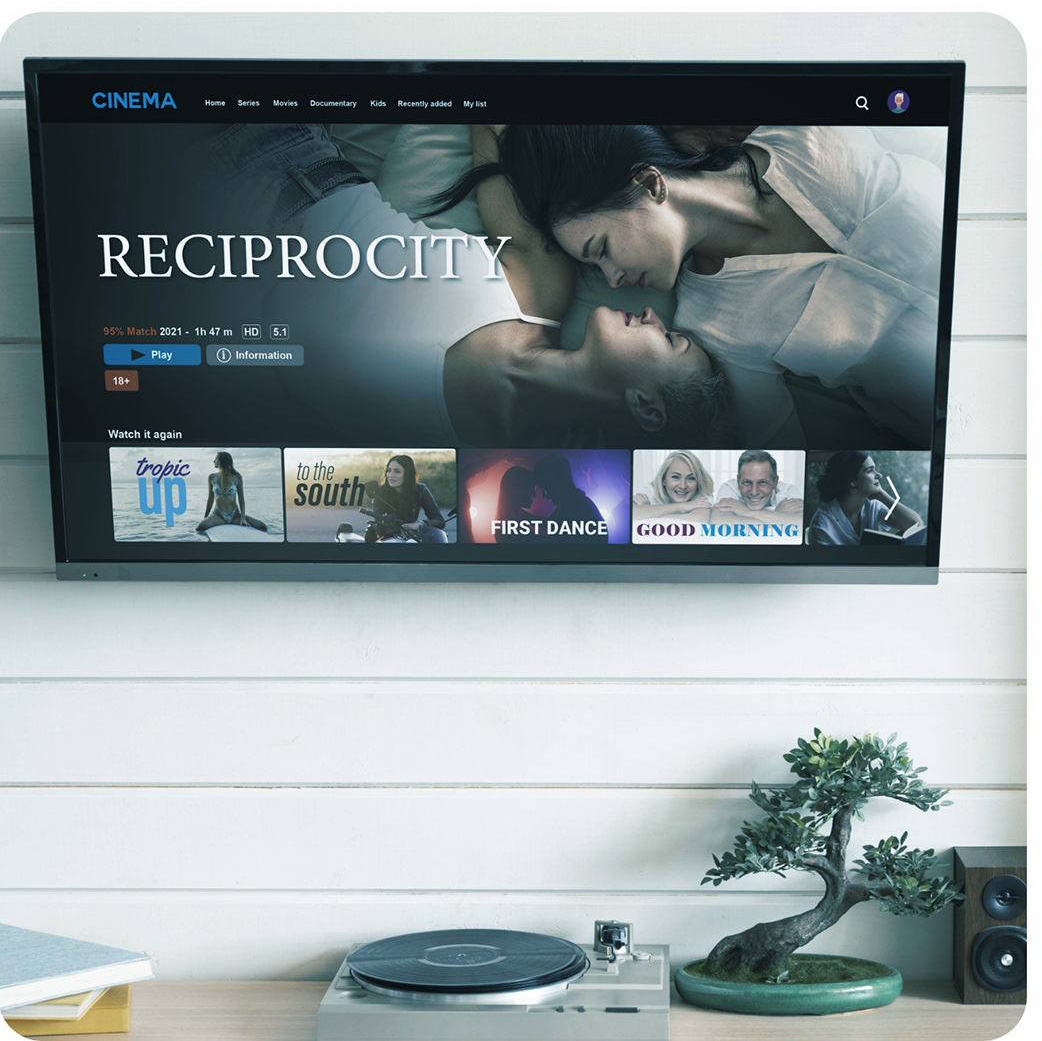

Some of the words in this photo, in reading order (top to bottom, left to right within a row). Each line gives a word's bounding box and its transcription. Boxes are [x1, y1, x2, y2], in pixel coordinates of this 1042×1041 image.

[92, 92, 177, 108] CINEMA
[205, 99, 226, 107] Home
[237, 99, 260, 107] Series
[273, 99, 298, 107] Movies
[310, 100, 357, 108] Documentary
[398, 100, 429, 108] Recently
[463, 100, 474, 108] My
[97, 234, 512, 279] RECIPROCITY
[103, 327, 125, 336] 95%
[127, 327, 157, 336] Match
[159, 327, 182, 336] 2021
[194, 327, 207, 336] 1h
[209, 327, 221, 336] 47
[244, 327, 259, 336] HD
[273, 327, 287, 337] 5.1
[151, 350, 173, 361] Play
[235, 350, 293, 360] Information
[112, 376, 130, 386] 18+
[108, 429, 141, 439] Watch
[143, 429, 152, 439] it
[153, 430, 183, 441] again
[136, 457, 191, 484] tropic
[296, 462, 310, 481] to
[313, 460, 335, 481] the
[294, 476, 366, 507] south
[137, 477, 188, 527] up
[491, 520, 542, 535] FIRST
[547, 520, 608, 535] DANCE
[636, 523, 695, 537] GOOD
[700, 523, 799, 537] MORNING
